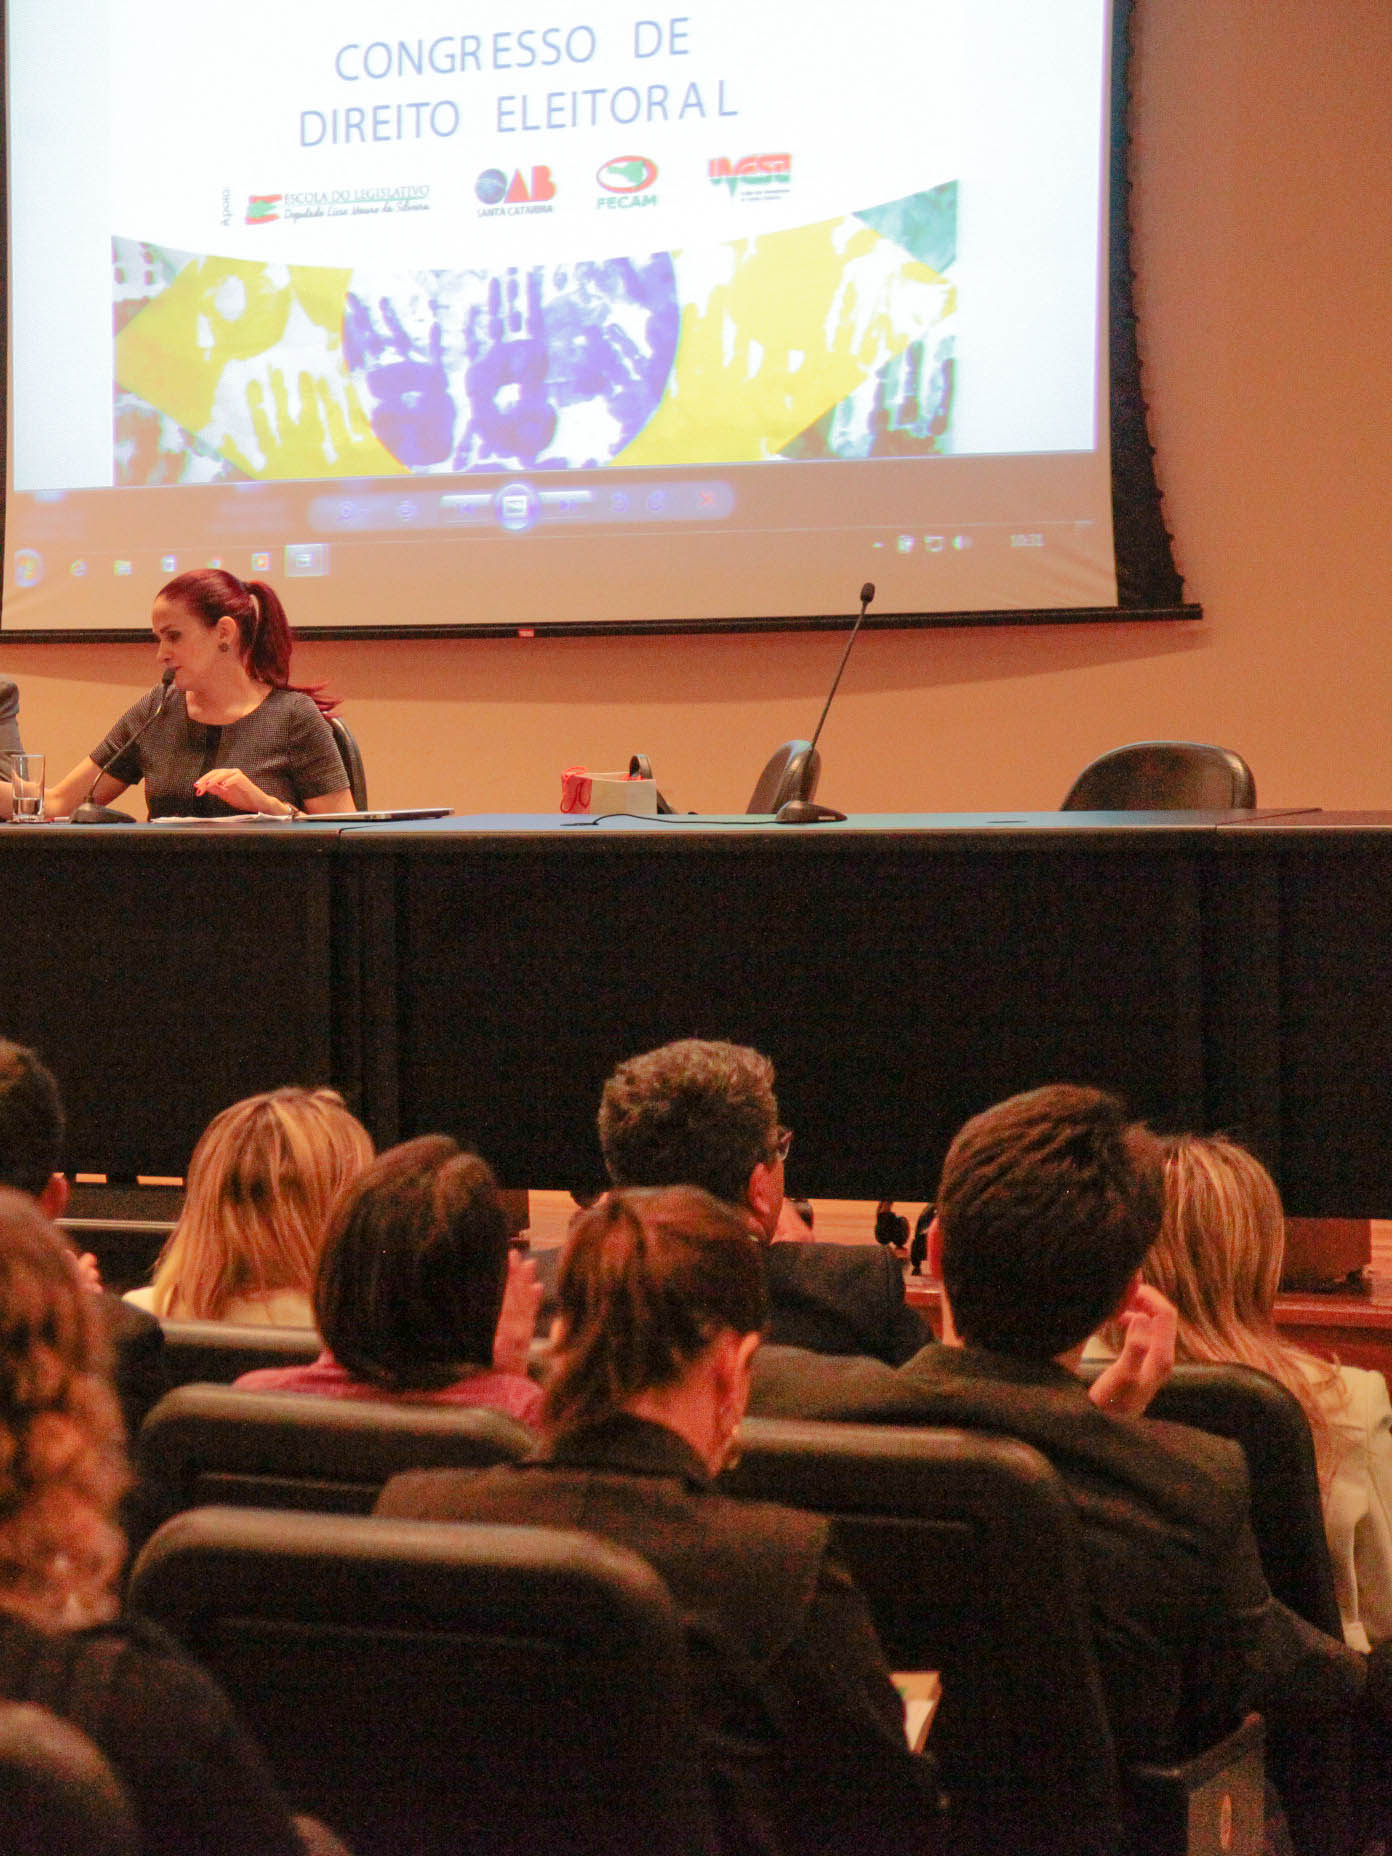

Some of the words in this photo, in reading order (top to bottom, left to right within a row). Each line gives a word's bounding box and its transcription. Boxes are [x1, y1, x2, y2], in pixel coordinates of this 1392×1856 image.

[335, 25, 596, 81] CONGRESSO
[634, 17, 690, 58] DE
[299, 100, 460, 147] DIREITO
[496, 79, 739, 133] ELEITORAL
[474, 164, 557, 205] OAB
[597, 194, 658, 210] FECAM
